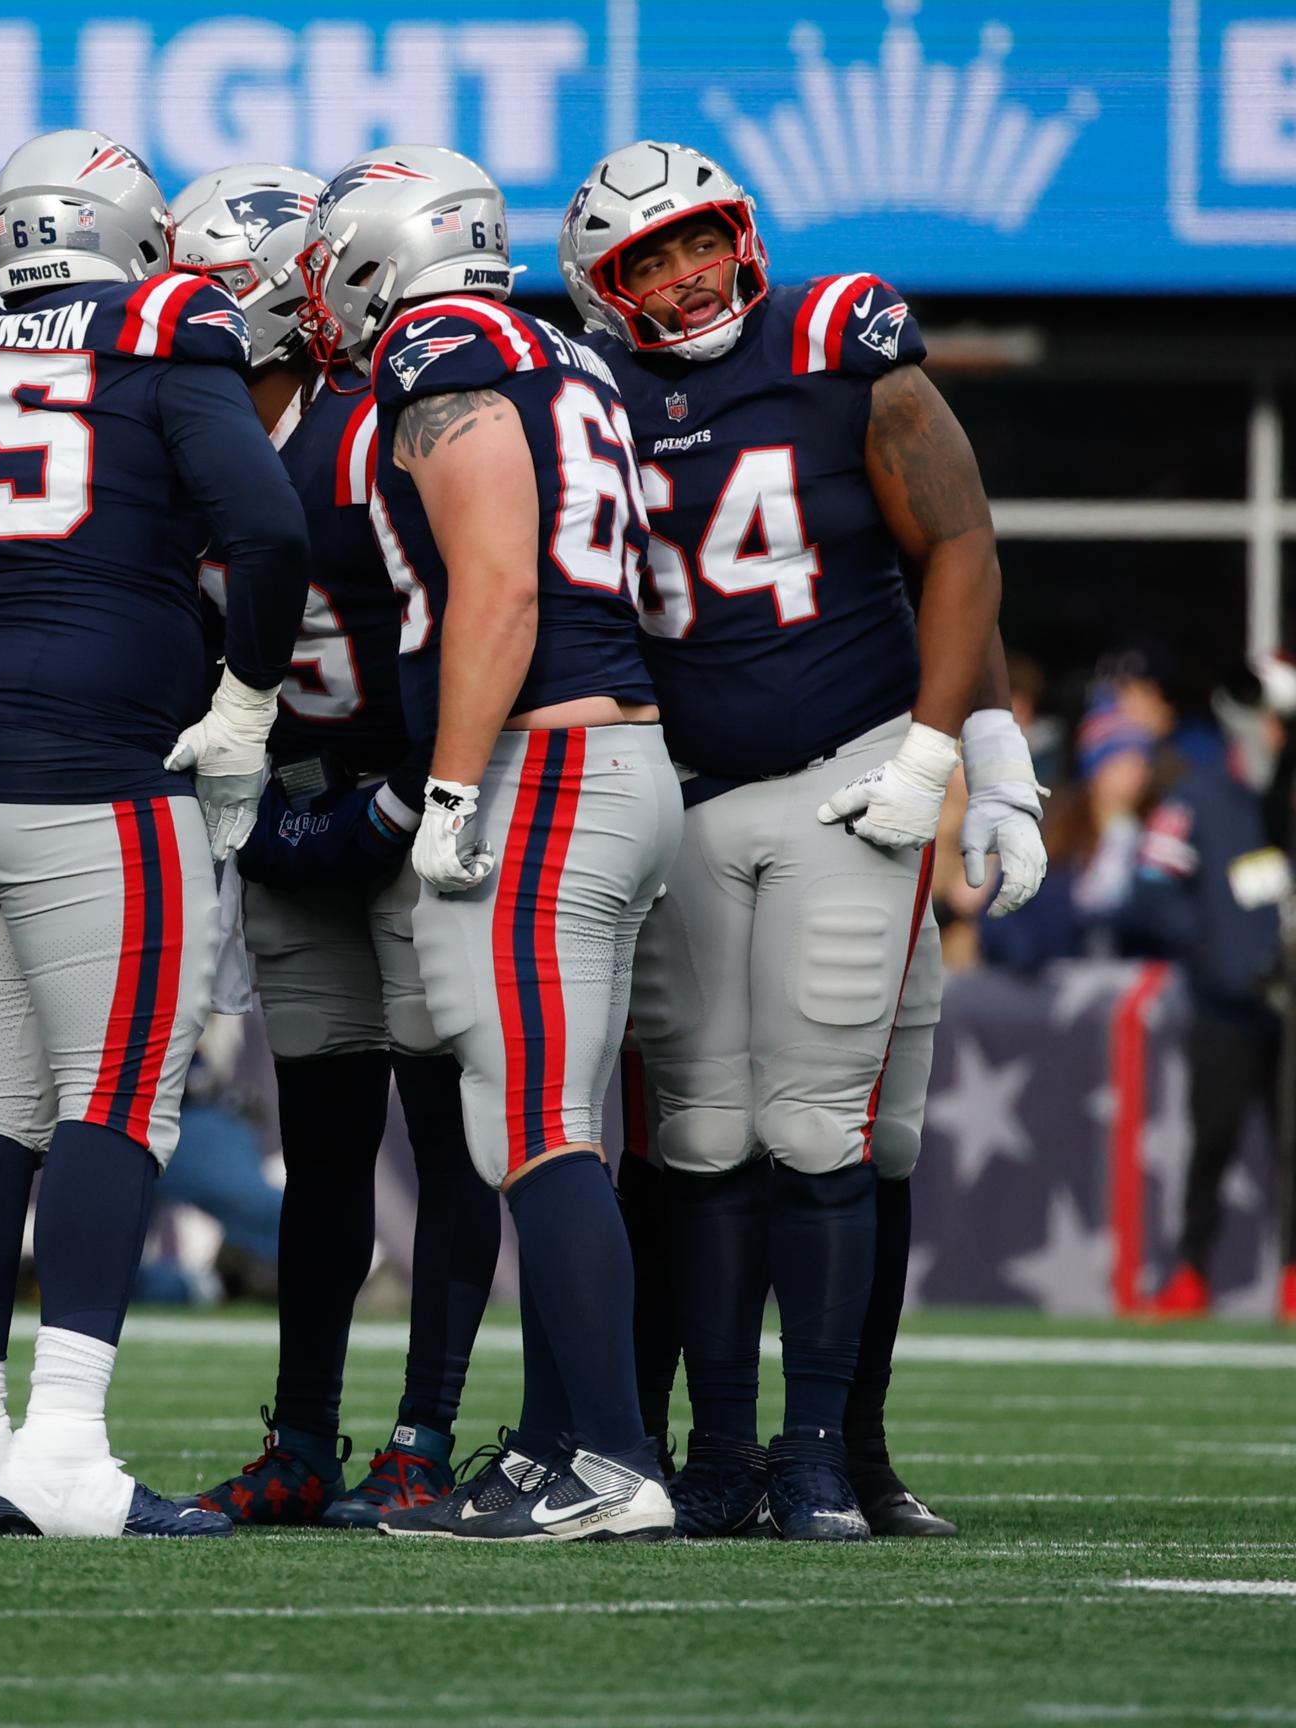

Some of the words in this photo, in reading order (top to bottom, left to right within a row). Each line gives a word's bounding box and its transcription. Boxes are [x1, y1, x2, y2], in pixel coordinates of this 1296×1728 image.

[641, 198, 675, 221] PATRIOTS
[12, 216, 57, 249] 65
[471, 221, 504, 251] 69
[8, 261, 72, 287] PATRIOTS
[464, 268, 510, 288] PATRIOTS
[653, 429, 712, 454] PATRIOTS
[429, 786, 464, 811] NIKE
[579, 1504, 631, 1528] FORCE
